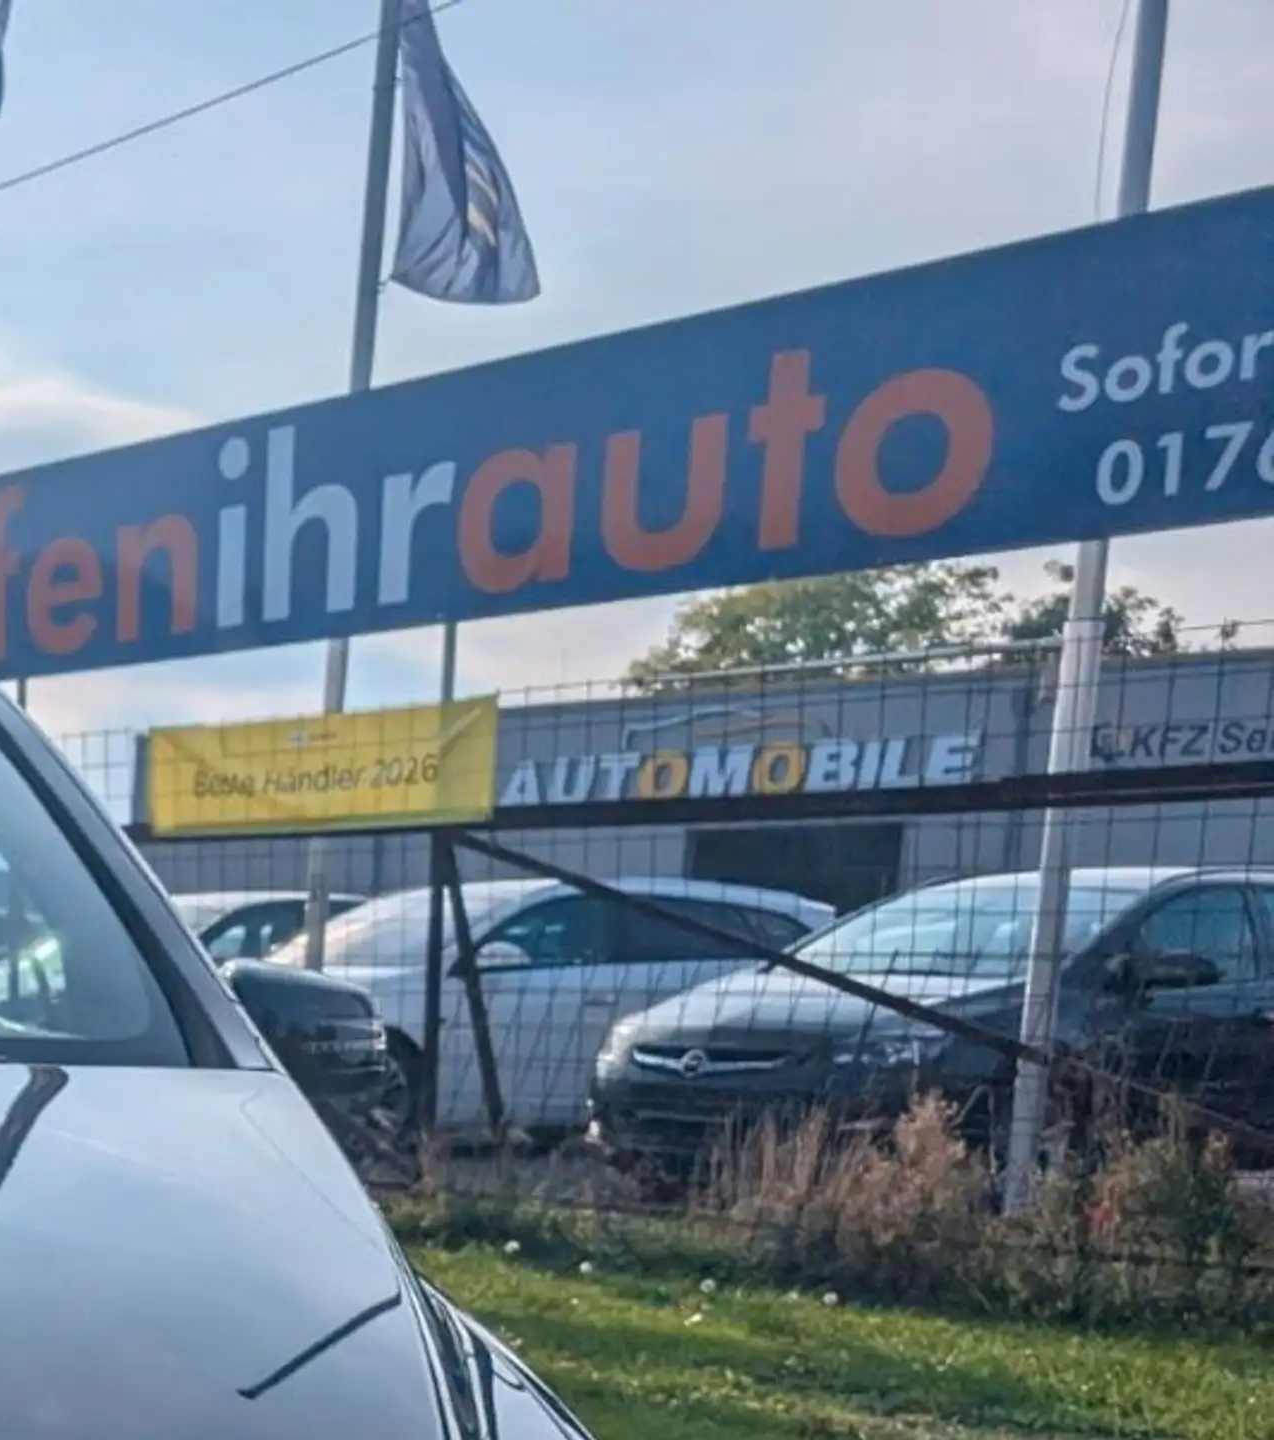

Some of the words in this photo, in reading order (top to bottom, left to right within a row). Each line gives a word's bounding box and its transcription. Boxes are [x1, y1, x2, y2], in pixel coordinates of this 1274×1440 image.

[1129, 723, 1208, 758] KFZ
[1217, 720, 1274, 755] Se
[369, 752, 439, 790] 2026
[499, 729, 981, 806] AUTOMOBILE
